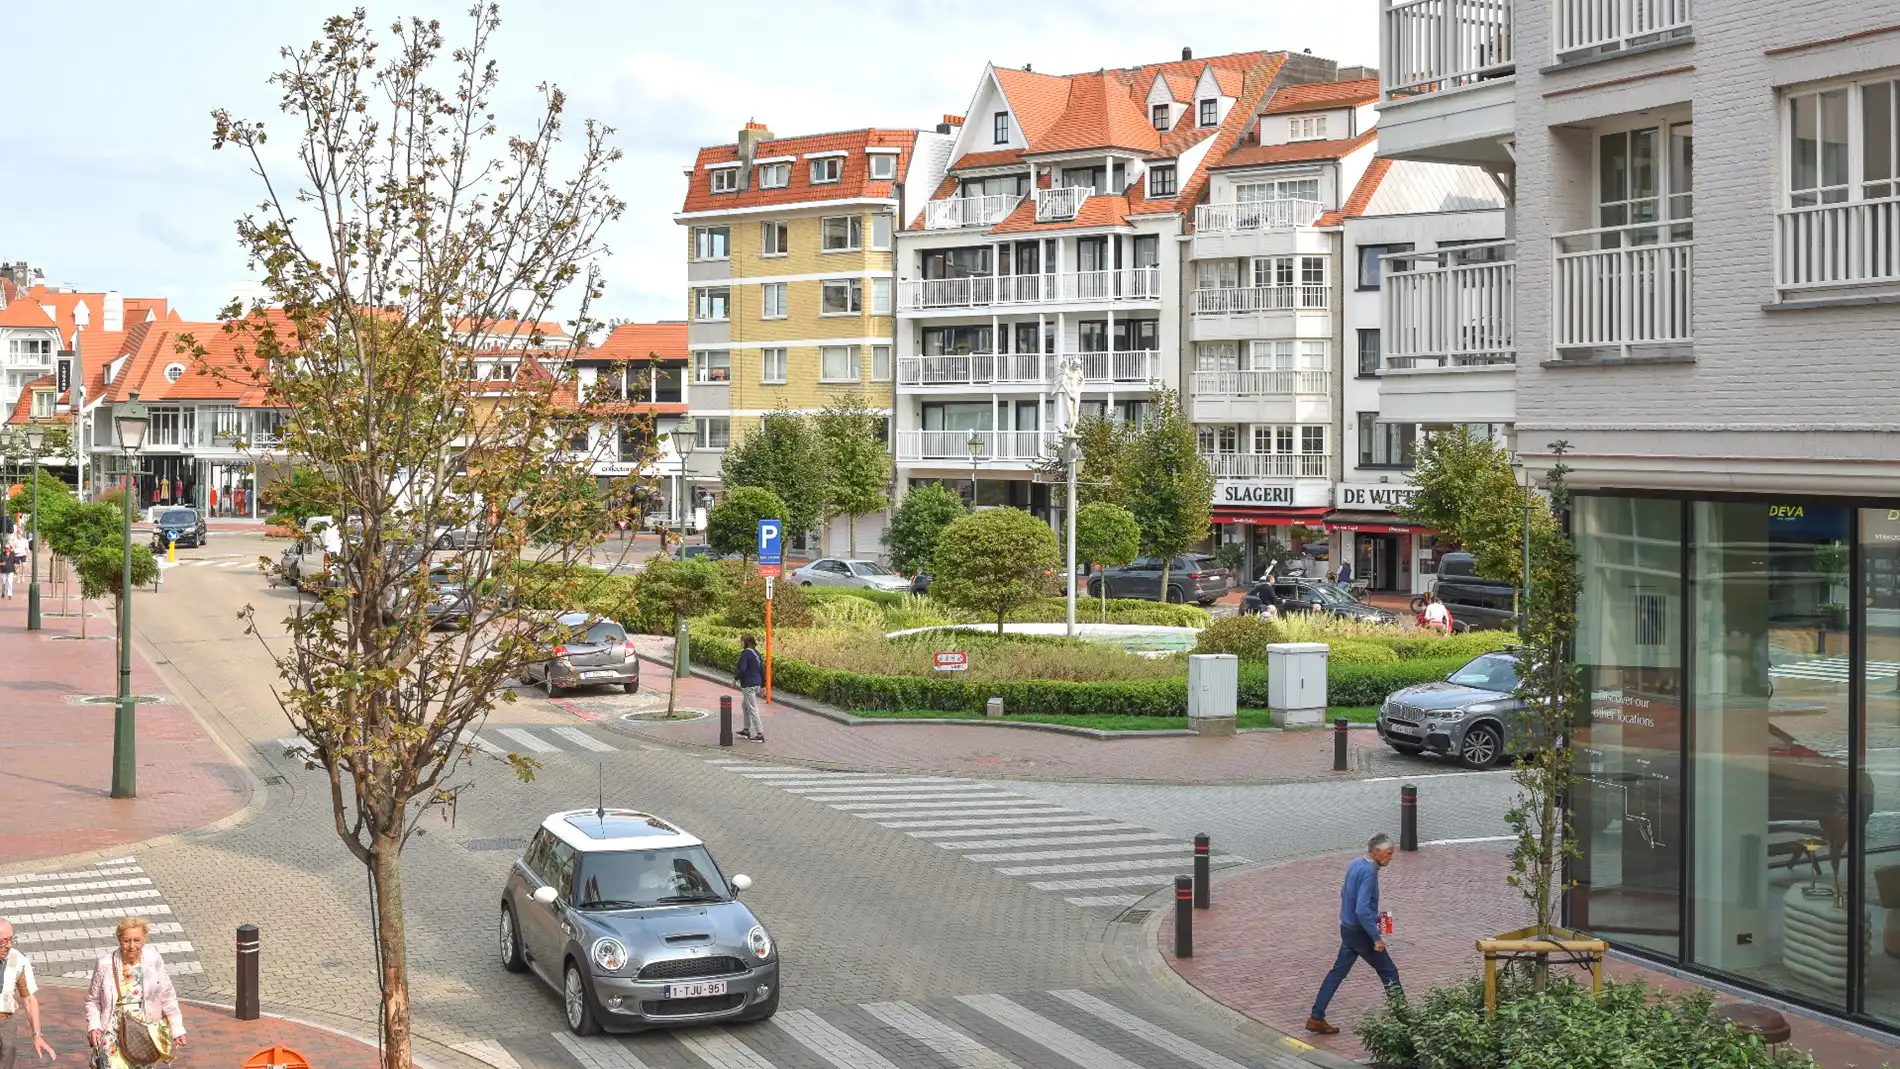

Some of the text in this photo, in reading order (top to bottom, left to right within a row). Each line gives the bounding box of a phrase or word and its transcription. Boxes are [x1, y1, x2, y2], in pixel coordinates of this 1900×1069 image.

[1225, 487, 1294, 506] SLAGERIJ
[1344, 489, 1365, 504] DE
[1769, 506, 1804, 517] DEVA
[762, 525, 778, 549] P
[1600, 689, 1650, 709] Discover our
[1593, 707, 1655, 728] other locations
[673, 983, 725, 997] 1-TJU-951
